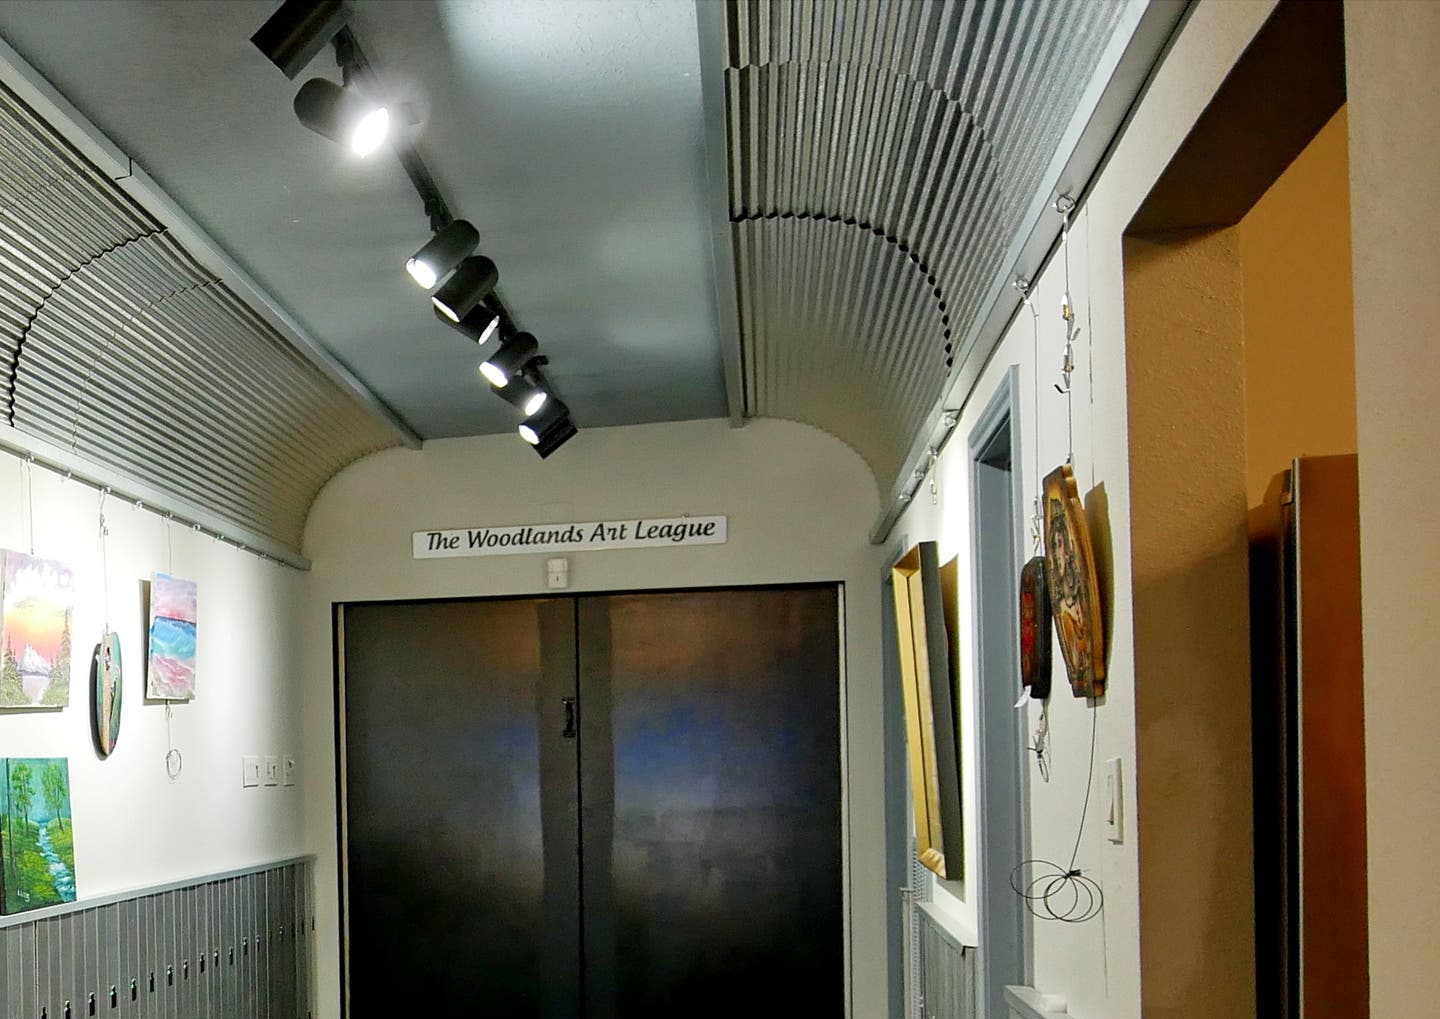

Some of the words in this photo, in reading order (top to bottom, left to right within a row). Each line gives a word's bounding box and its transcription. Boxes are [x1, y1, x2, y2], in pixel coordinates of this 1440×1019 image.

[427, 532, 460, 551] The
[467, 525, 584, 549] Woodlands
[589, 522, 628, 542] Art
[635, 520, 716, 542] League
